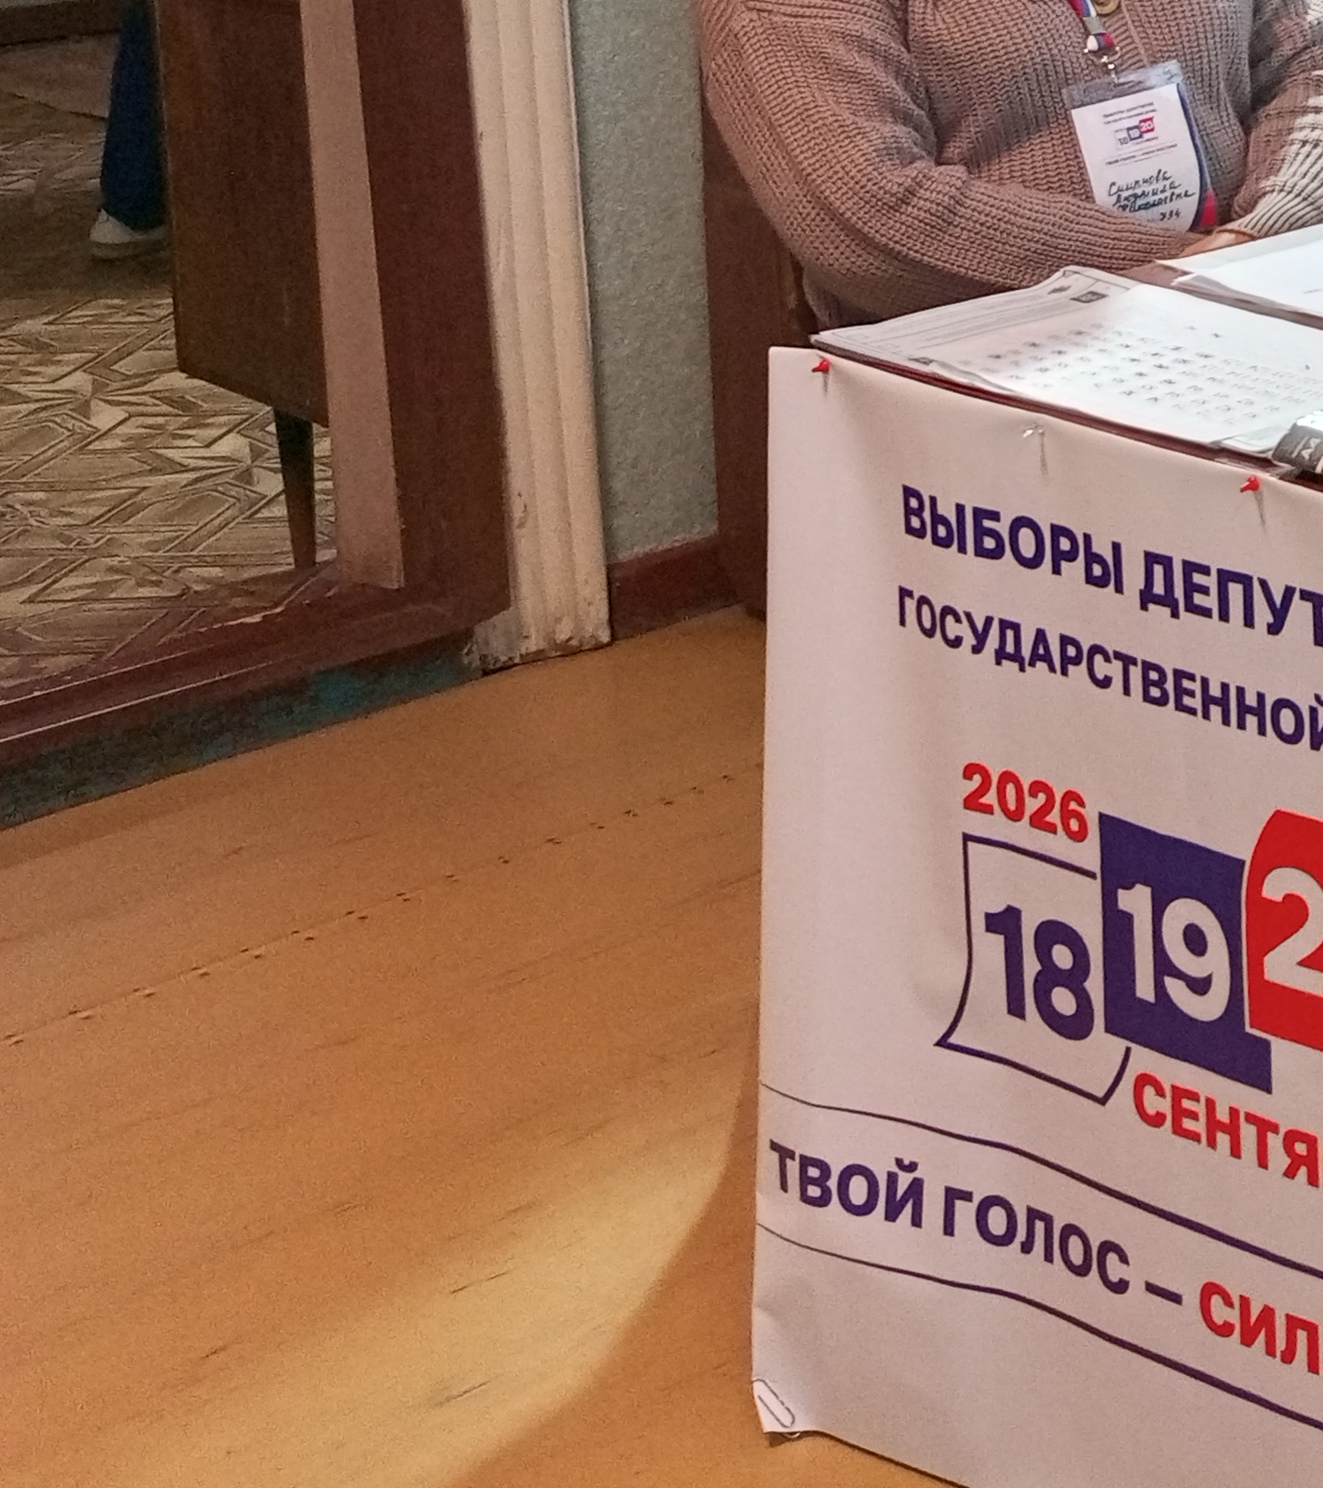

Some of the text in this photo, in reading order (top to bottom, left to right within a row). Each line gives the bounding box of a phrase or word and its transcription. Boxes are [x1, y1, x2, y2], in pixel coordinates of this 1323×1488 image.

[901, 484, 1124, 593] ВЫБОРЫ
[961, 760, 1091, 844] 2026
[984, 904, 1096, 1042] 18
[1116, 883, 1233, 1024] 19
[769, 1138, 926, 1231] ТВОЙ
[941, 1187, 1132, 1296] ГОЛОС
